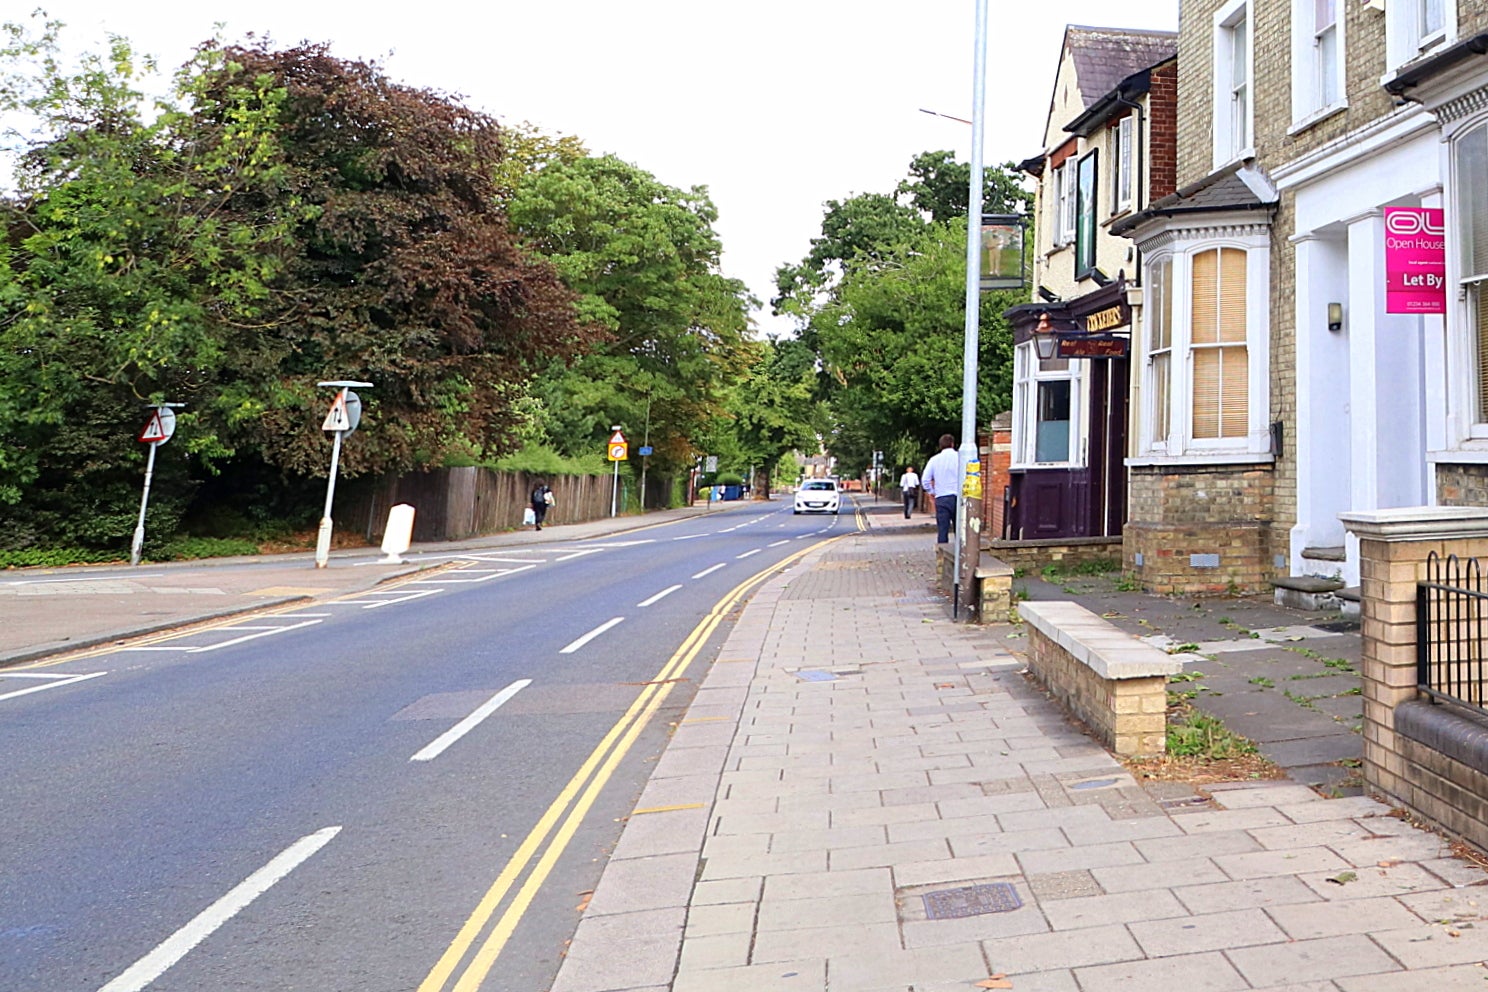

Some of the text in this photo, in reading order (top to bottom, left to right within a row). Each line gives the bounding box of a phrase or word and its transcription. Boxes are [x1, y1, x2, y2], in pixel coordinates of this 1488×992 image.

[1386, 237, 1445, 251] Open House
[1403, 273, 1443, 289] Let By
